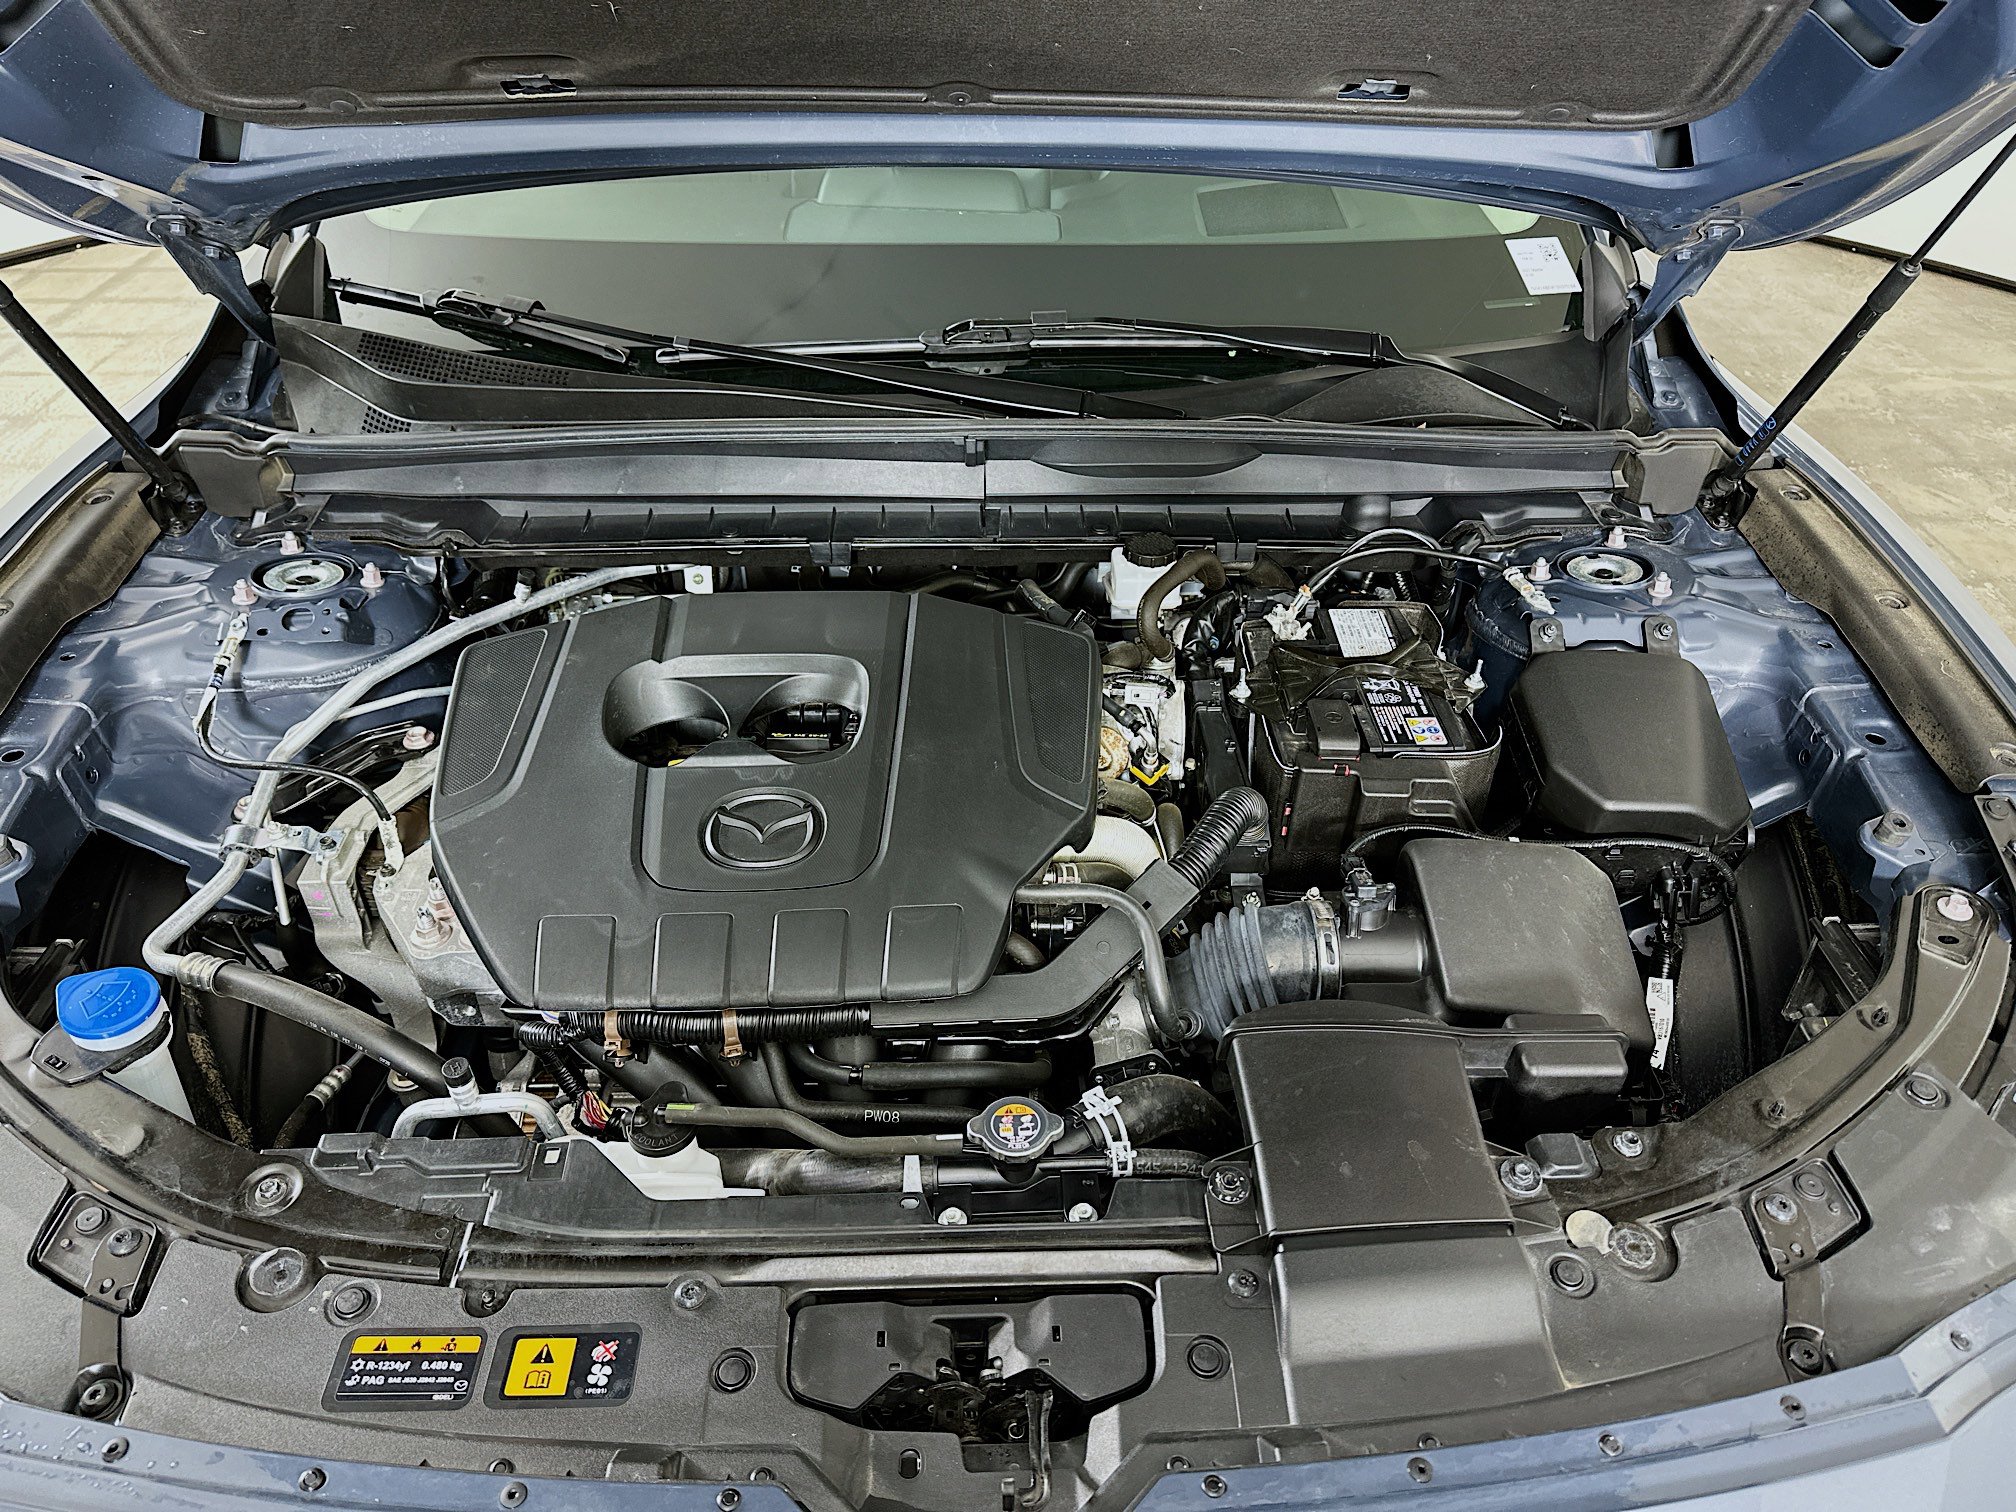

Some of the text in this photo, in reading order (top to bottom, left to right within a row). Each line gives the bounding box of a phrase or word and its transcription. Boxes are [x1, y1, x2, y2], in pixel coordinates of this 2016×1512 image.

[864, 1109, 900, 1123] PW08
[634, 1132, 679, 1147] COOLANT
[366, 1360, 463, 1372] R-1234yf 0.480 kg
[360, 1375, 386, 1385] PAG
